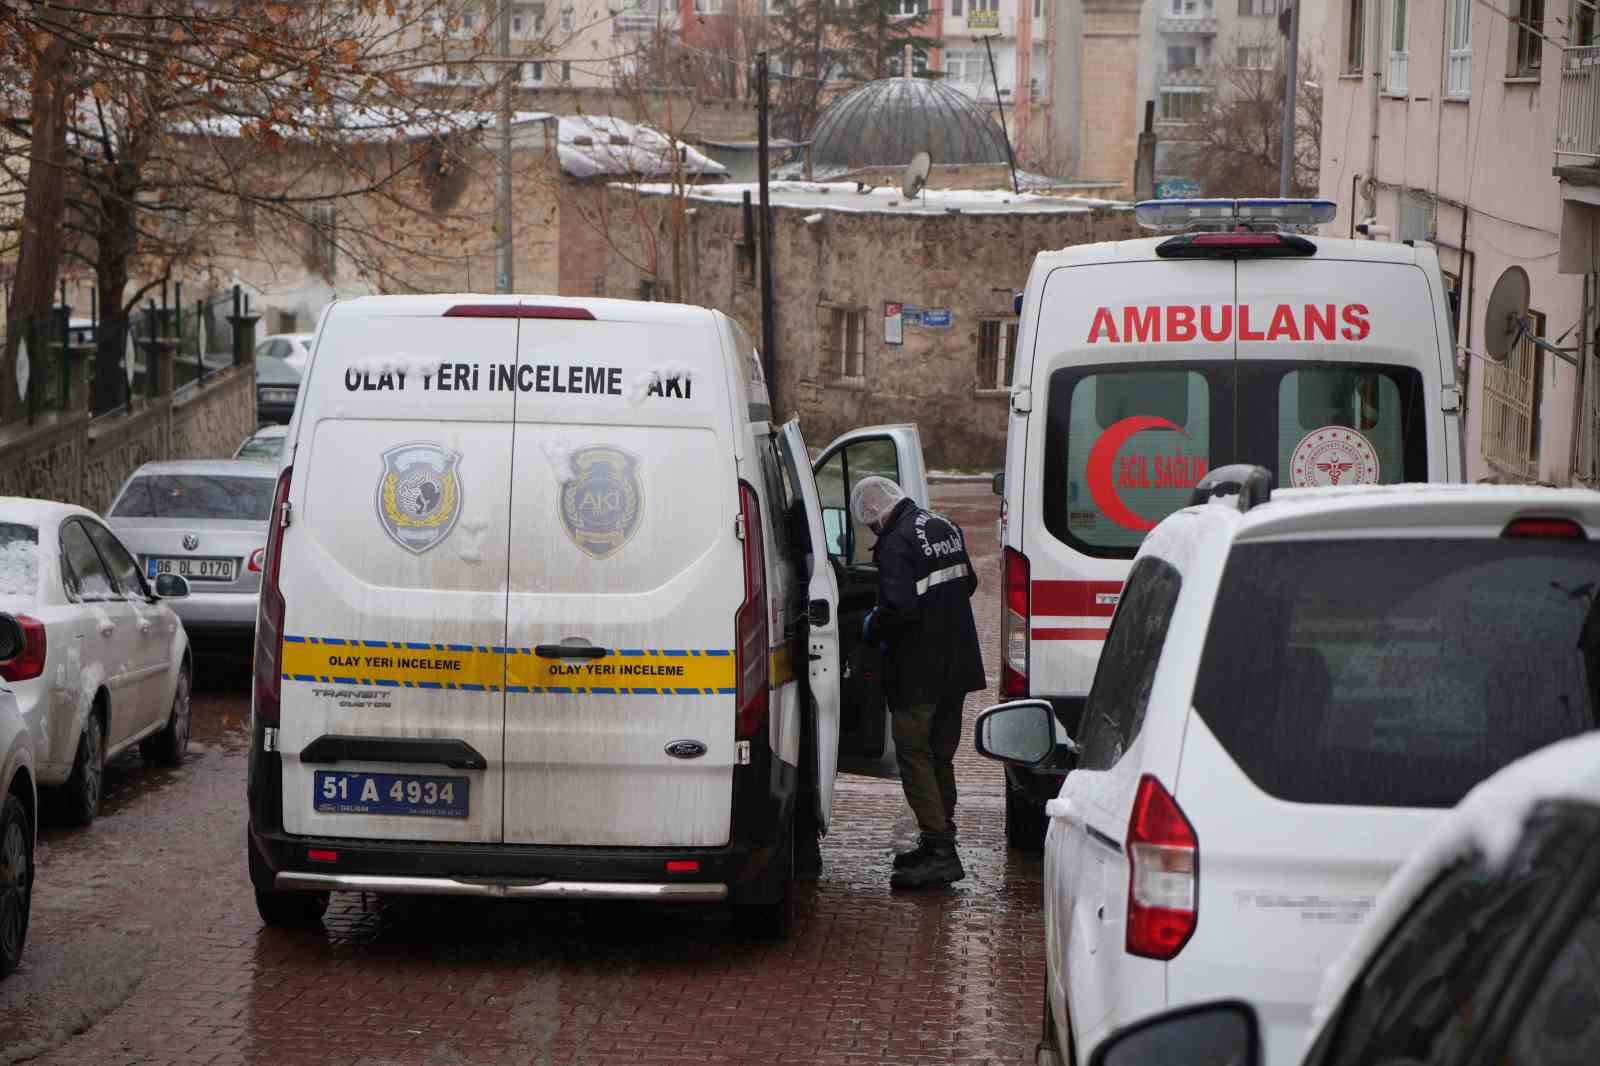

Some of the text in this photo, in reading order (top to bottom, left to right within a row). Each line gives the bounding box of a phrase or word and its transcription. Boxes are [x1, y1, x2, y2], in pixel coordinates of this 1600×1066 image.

[1087, 303, 1371, 343] AMBULANS
[345, 364, 407, 391] OLAY
[156, 560, 230, 576] 06 DL 0170
[328, 655, 361, 666] OLAY
[549, 664, 582, 676] OLAY
[322, 776, 455, 804] 51 A 4934
